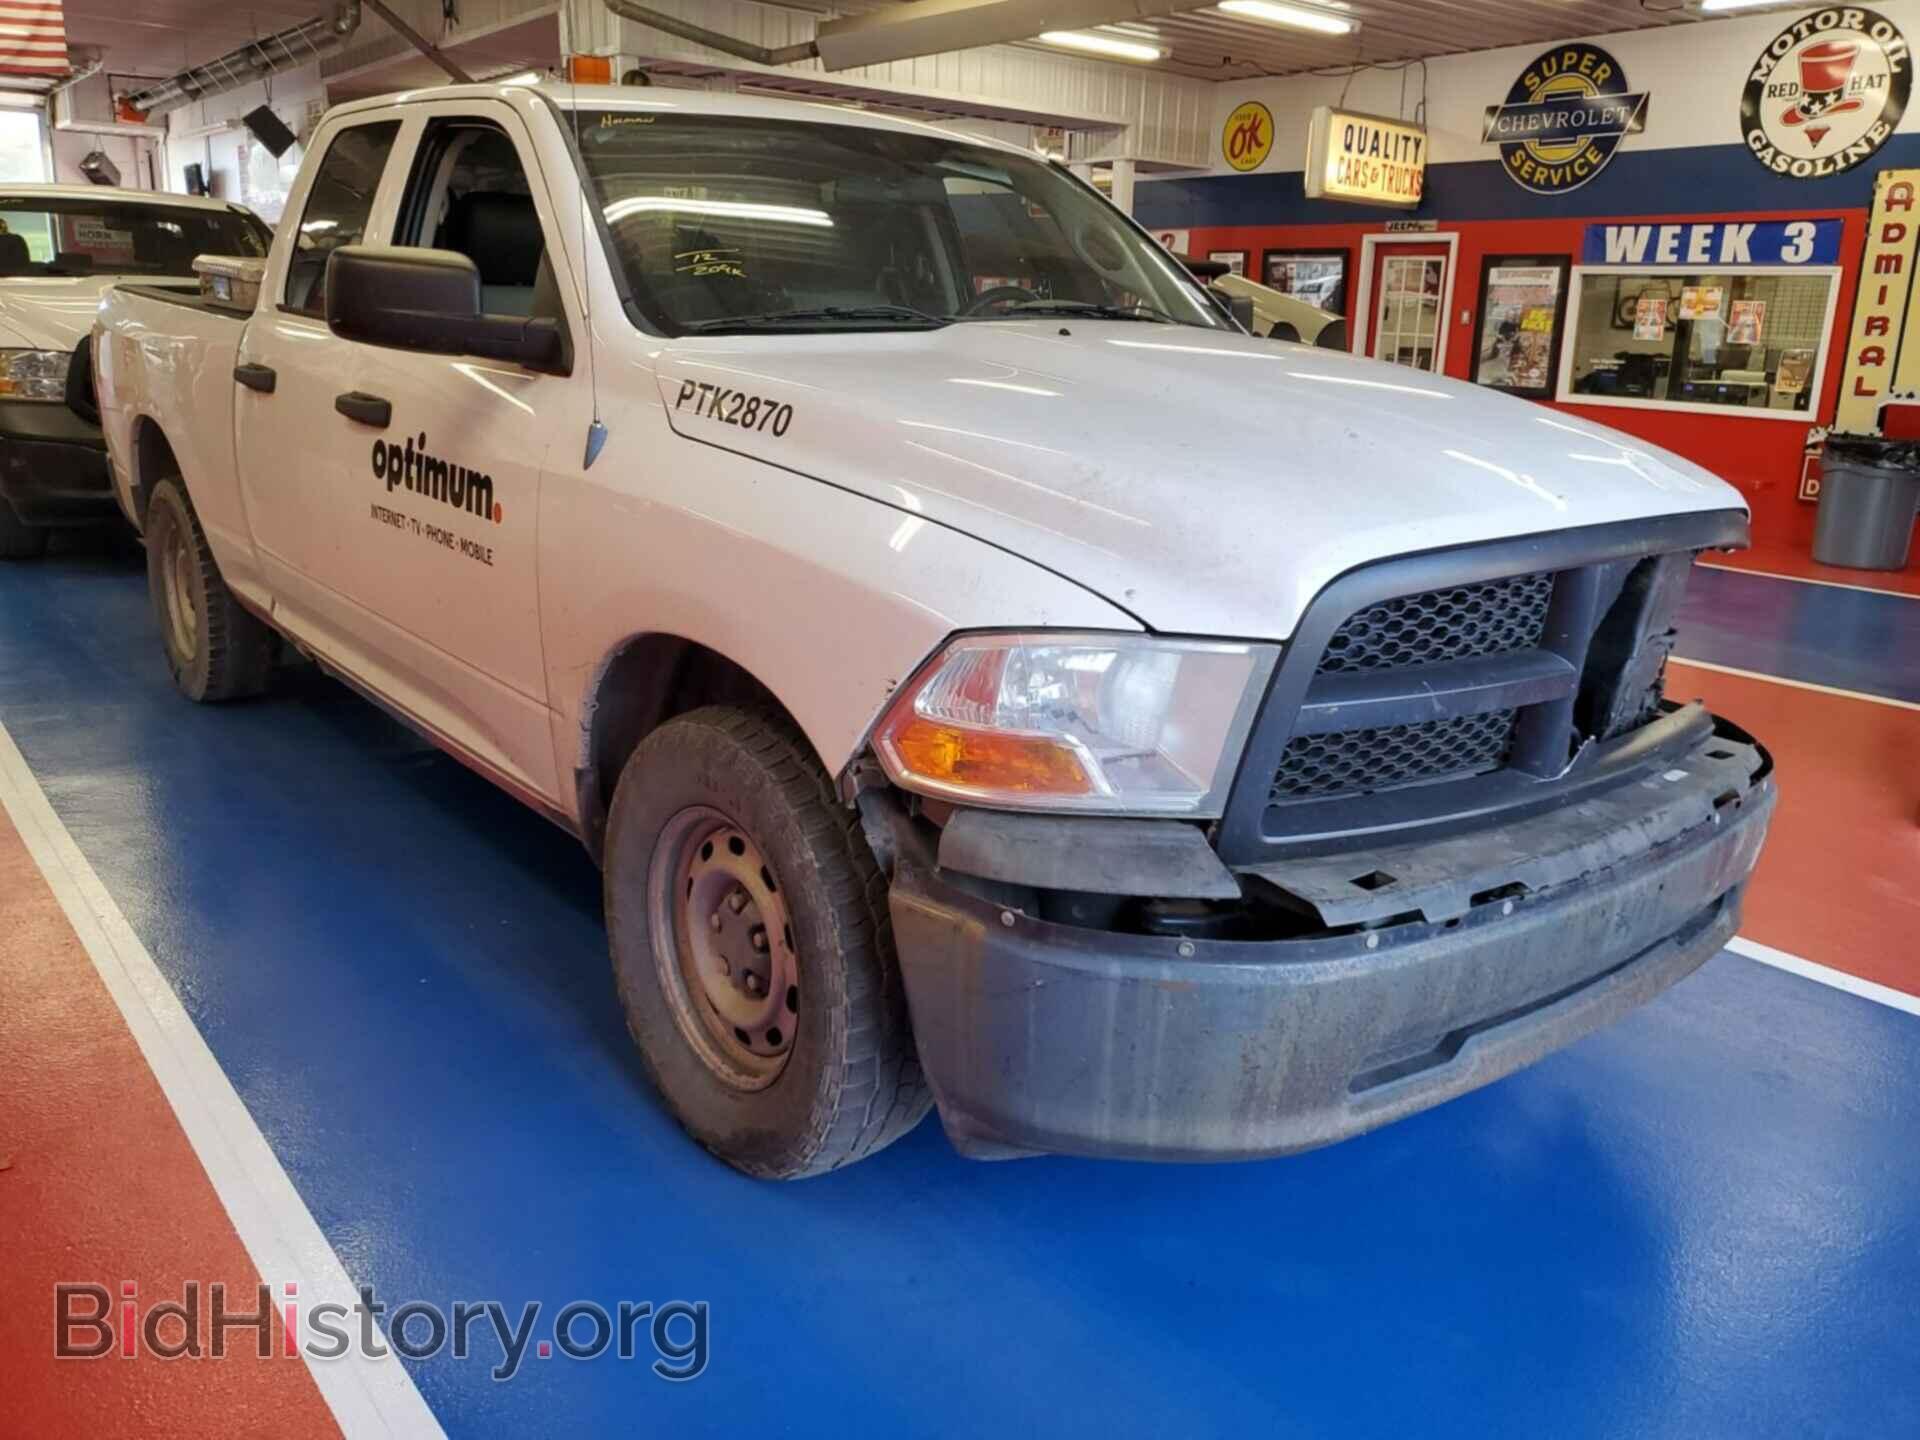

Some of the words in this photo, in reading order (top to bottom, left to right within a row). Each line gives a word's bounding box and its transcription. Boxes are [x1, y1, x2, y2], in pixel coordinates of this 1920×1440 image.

[1751, 9, 1865, 84] MOTOR
[1870, 21, 1909, 73] OIL
[1524, 52, 1611, 92] SUPER
[1768, 83, 1799, 98] RED
[1851, 74, 1887, 91] HAT
[1230, 112, 1264, 159] OK
[1497, 106, 1630, 133] CHEVROLET
[1344, 124, 1422, 165] QUALITY
[1510, 145, 1603, 186] SERVICE
[1748, 121, 1891, 177] GASOLINE
[1337, 156, 1369, 188] CARS
[1381, 164, 1423, 197] TRUCKS
[1605, 224, 1756, 263] WEEK
[1780, 221, 1817, 264] 3
[1853, 181, 1915, 397] ADMIRAL
[675, 379, 793, 437] PTK2870
[372, 431, 502, 525] optimum.
[370, 503, 406, 529] INTERNET
[410, 517, 421, 536] TV
[425, 523, 455, 550] PHONE
[460, 537, 494, 567] MOBILE
